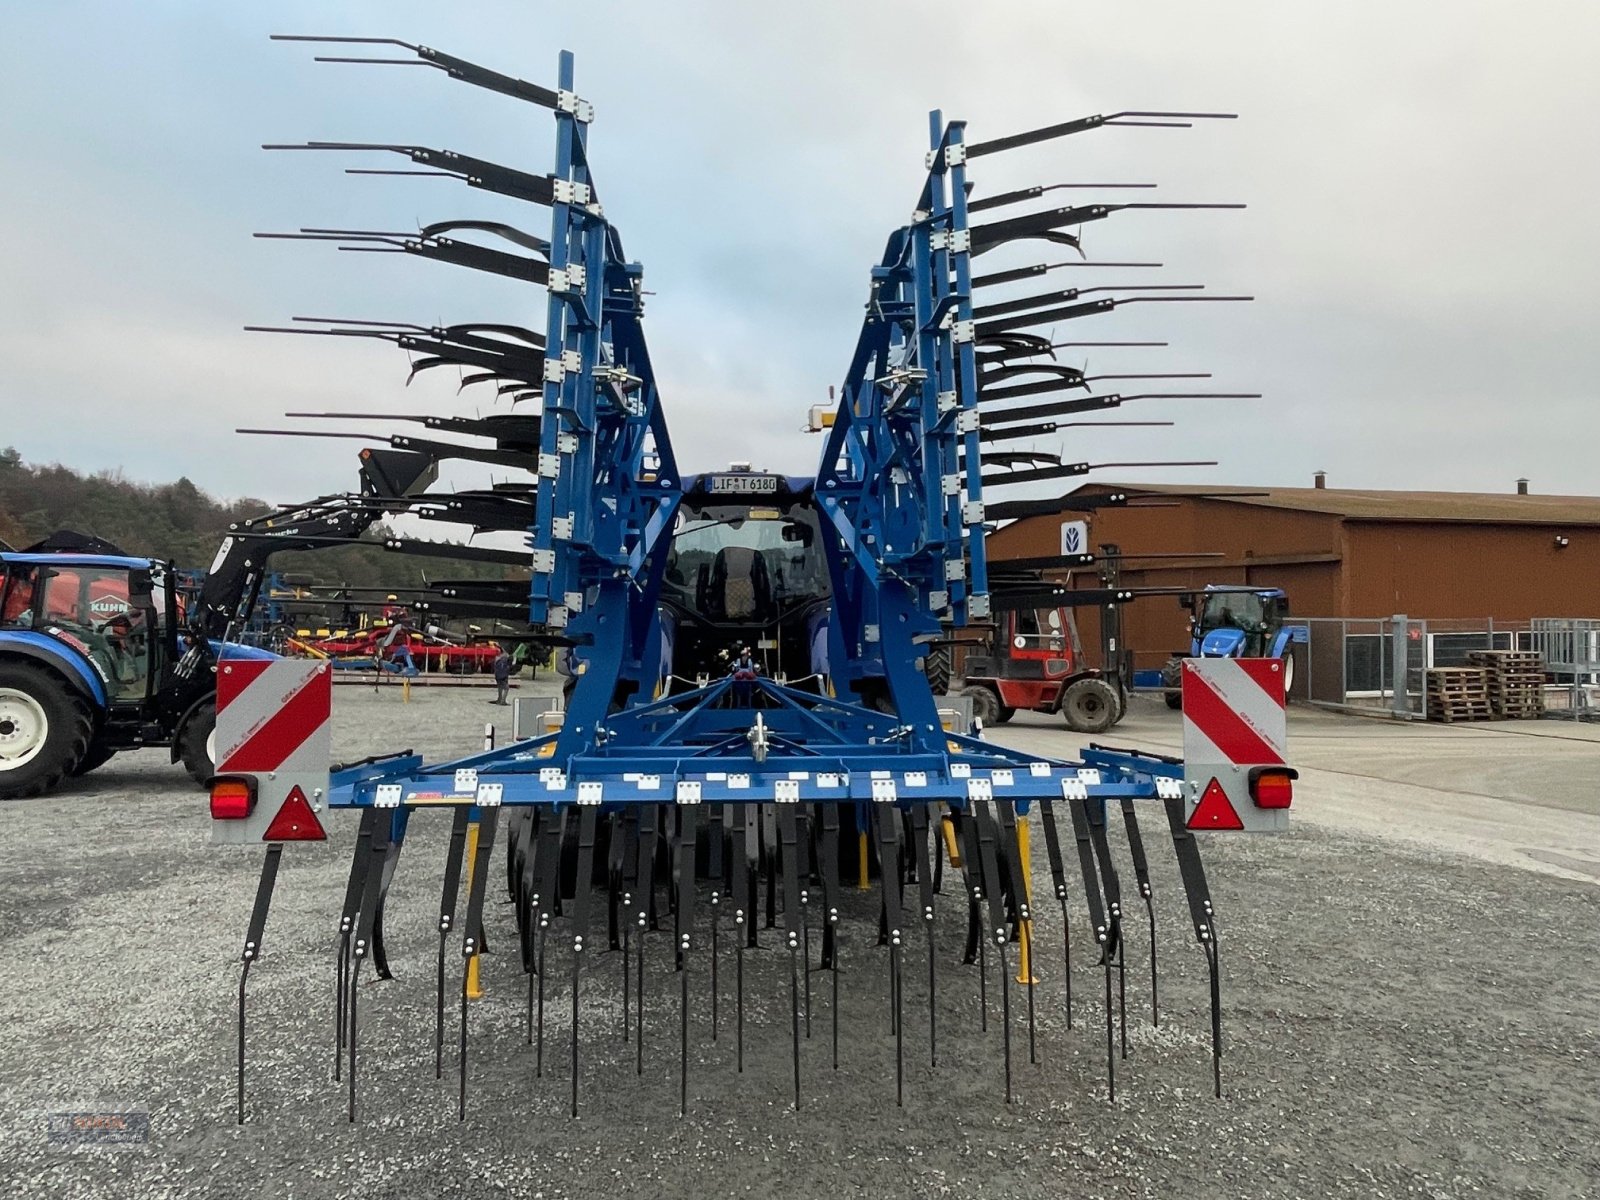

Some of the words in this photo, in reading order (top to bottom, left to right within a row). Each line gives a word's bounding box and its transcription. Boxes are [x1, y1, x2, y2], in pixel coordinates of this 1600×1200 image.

[713, 478, 732, 490] LIF
[742, 478, 748, 490] T
[750, 478, 775, 490] 6180
[91, 603, 128, 612] KUHN
